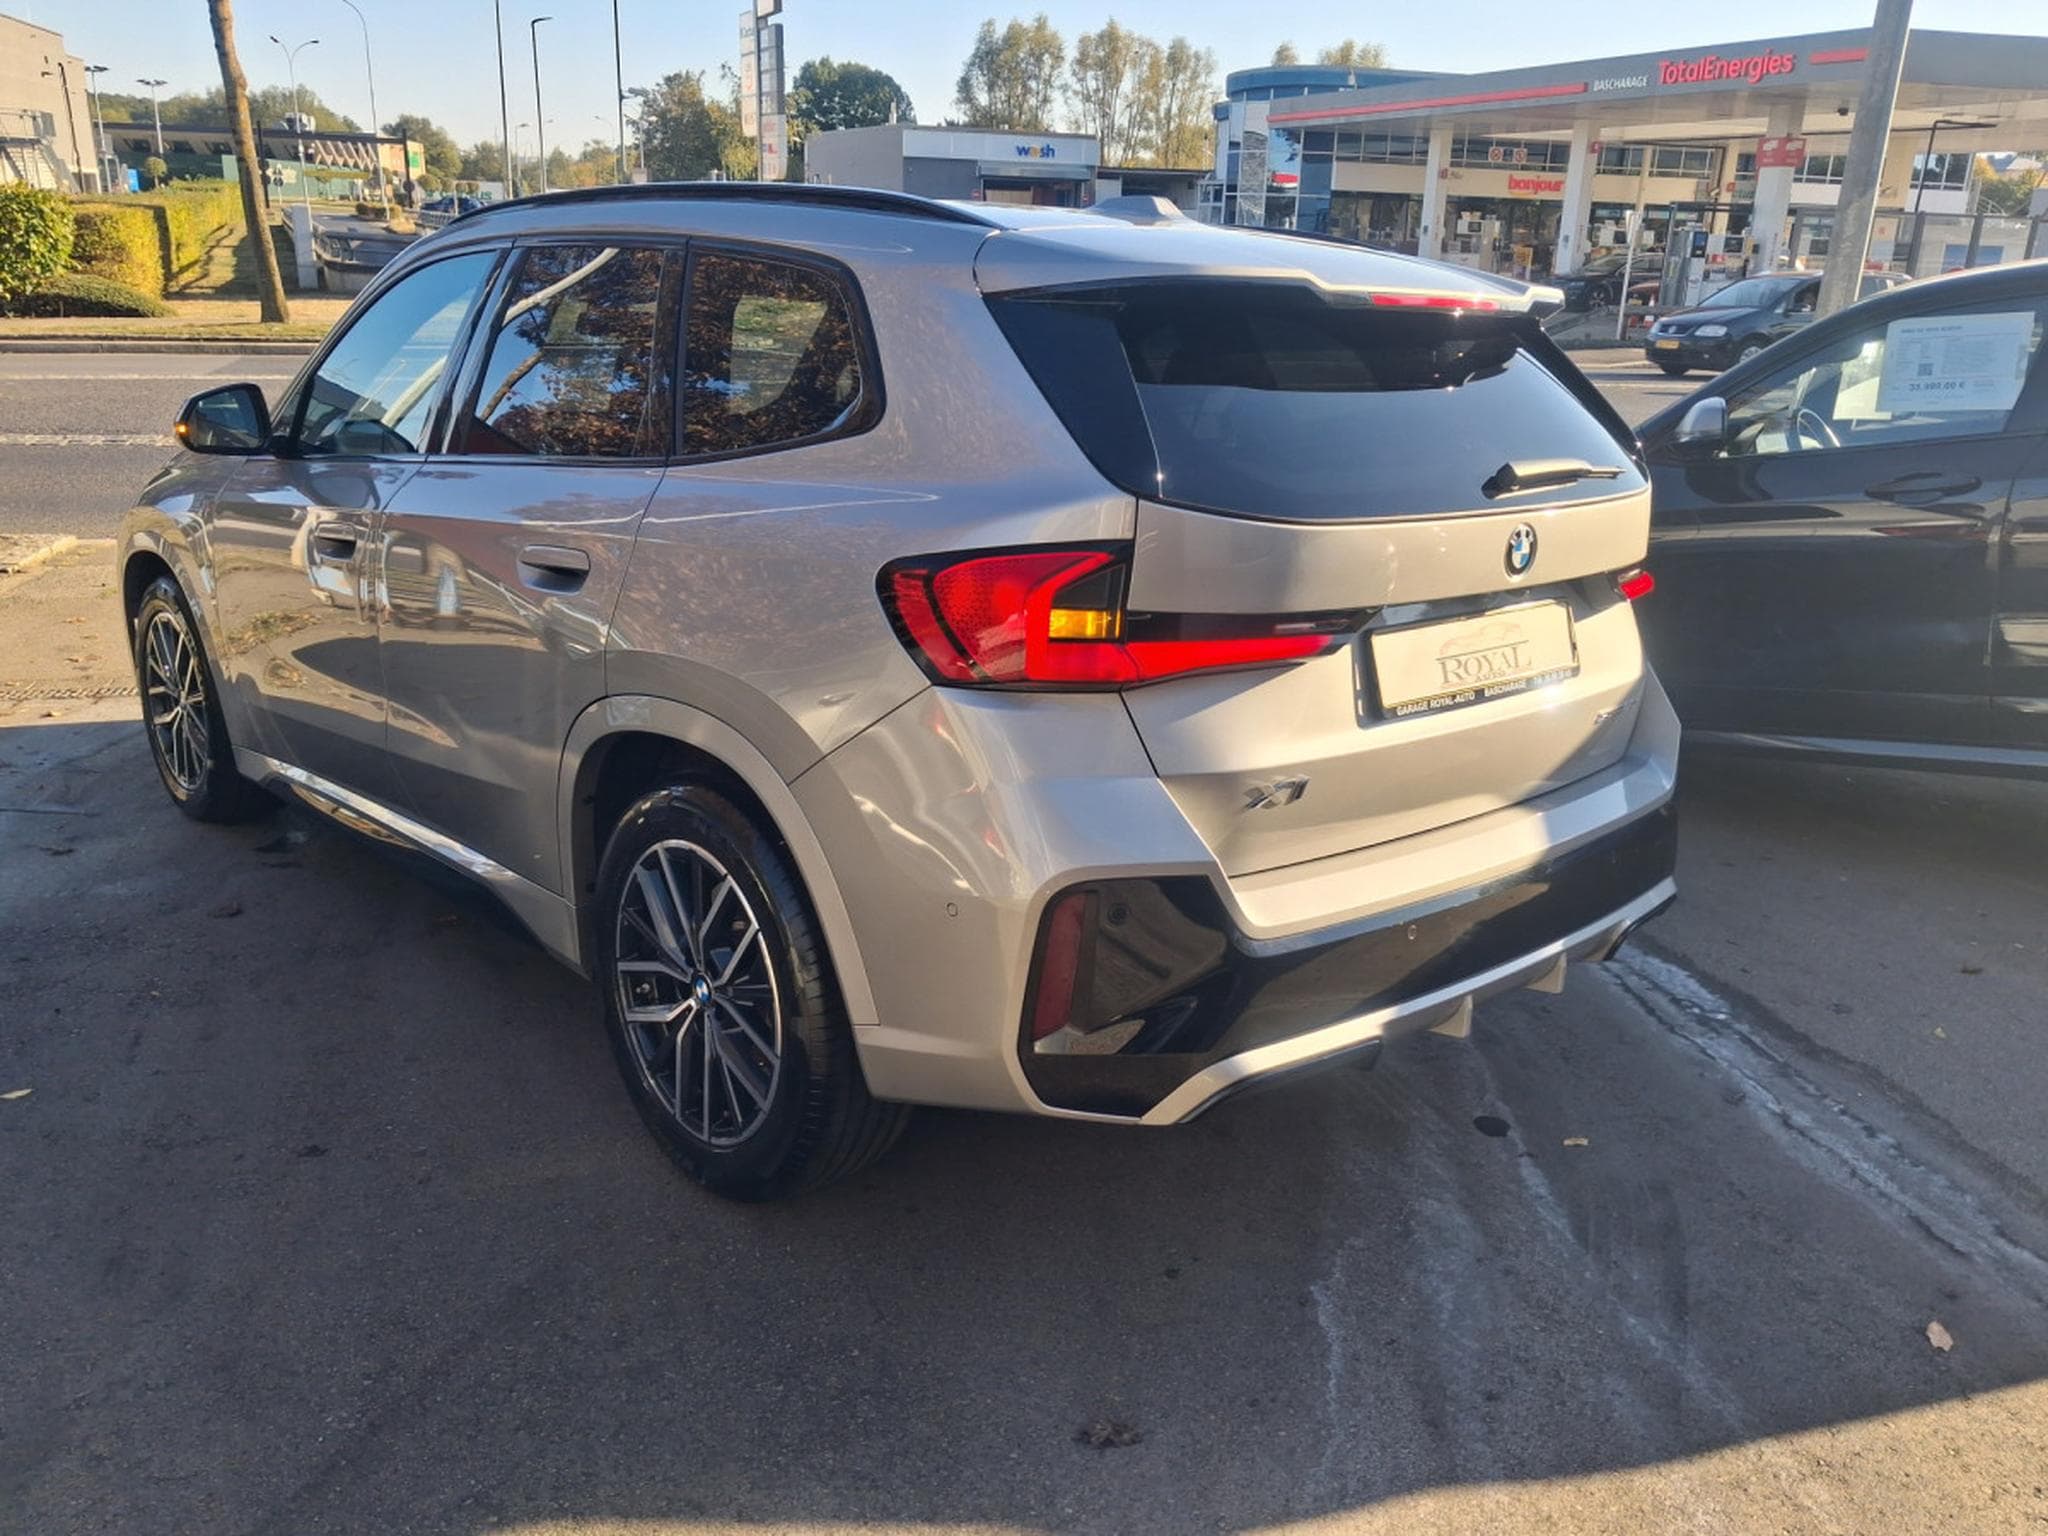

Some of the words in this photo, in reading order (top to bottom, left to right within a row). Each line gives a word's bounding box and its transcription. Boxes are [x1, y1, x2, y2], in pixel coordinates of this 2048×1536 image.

[1658, 50, 1797, 84] TotalEnergies
[1594, 75, 1648, 91] BASCHARAGE
[1508, 174, 1565, 194] bonjour
[1439, 646, 1532, 684] ROYAL
[1396, 701, 1429, 717] GARAGE
